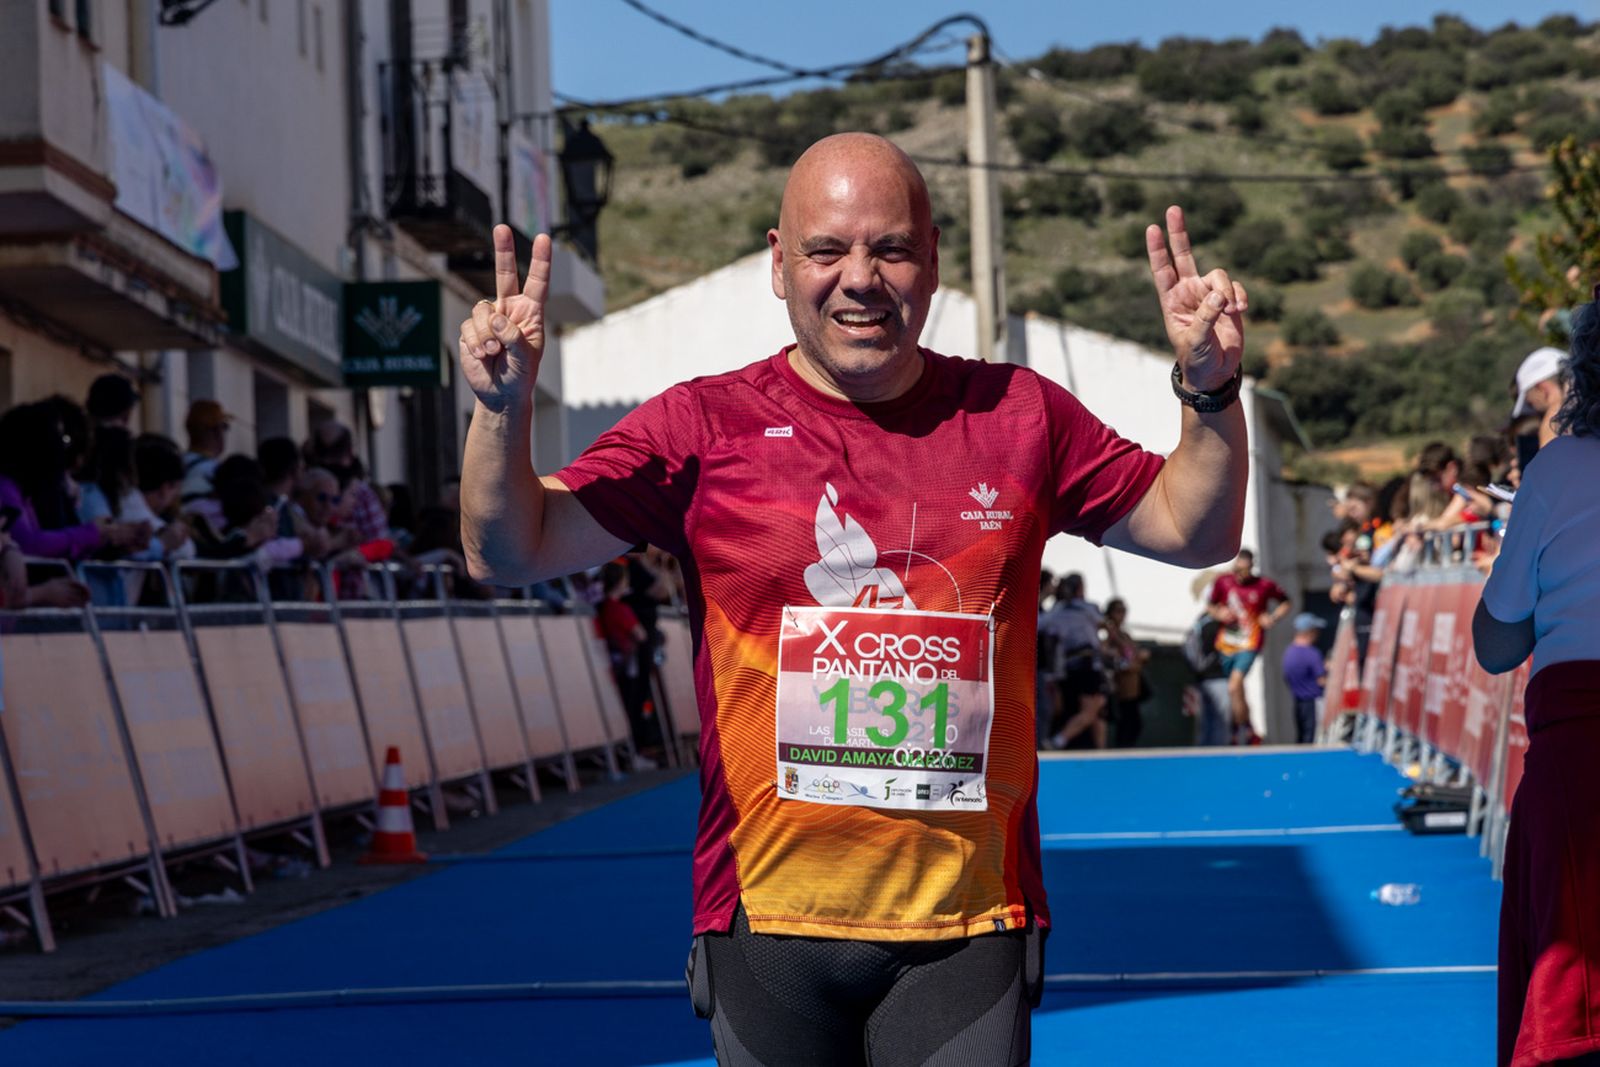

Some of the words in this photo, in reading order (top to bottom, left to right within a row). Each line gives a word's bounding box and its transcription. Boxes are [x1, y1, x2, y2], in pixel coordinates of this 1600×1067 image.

[960, 511, 985, 520] CAJA
[985, 510, 1014, 520] RURAL
[814, 620, 848, 655] X
[854, 632, 960, 663] CROSS
[813, 658, 937, 685] PANTANO
[941, 669, 960, 680] DEL
[819, 677, 950, 749] 131
[809, 725, 831, 735] LAS
[790, 748, 837, 764] DAVID
[841, 751, 897, 767] AMAYA
